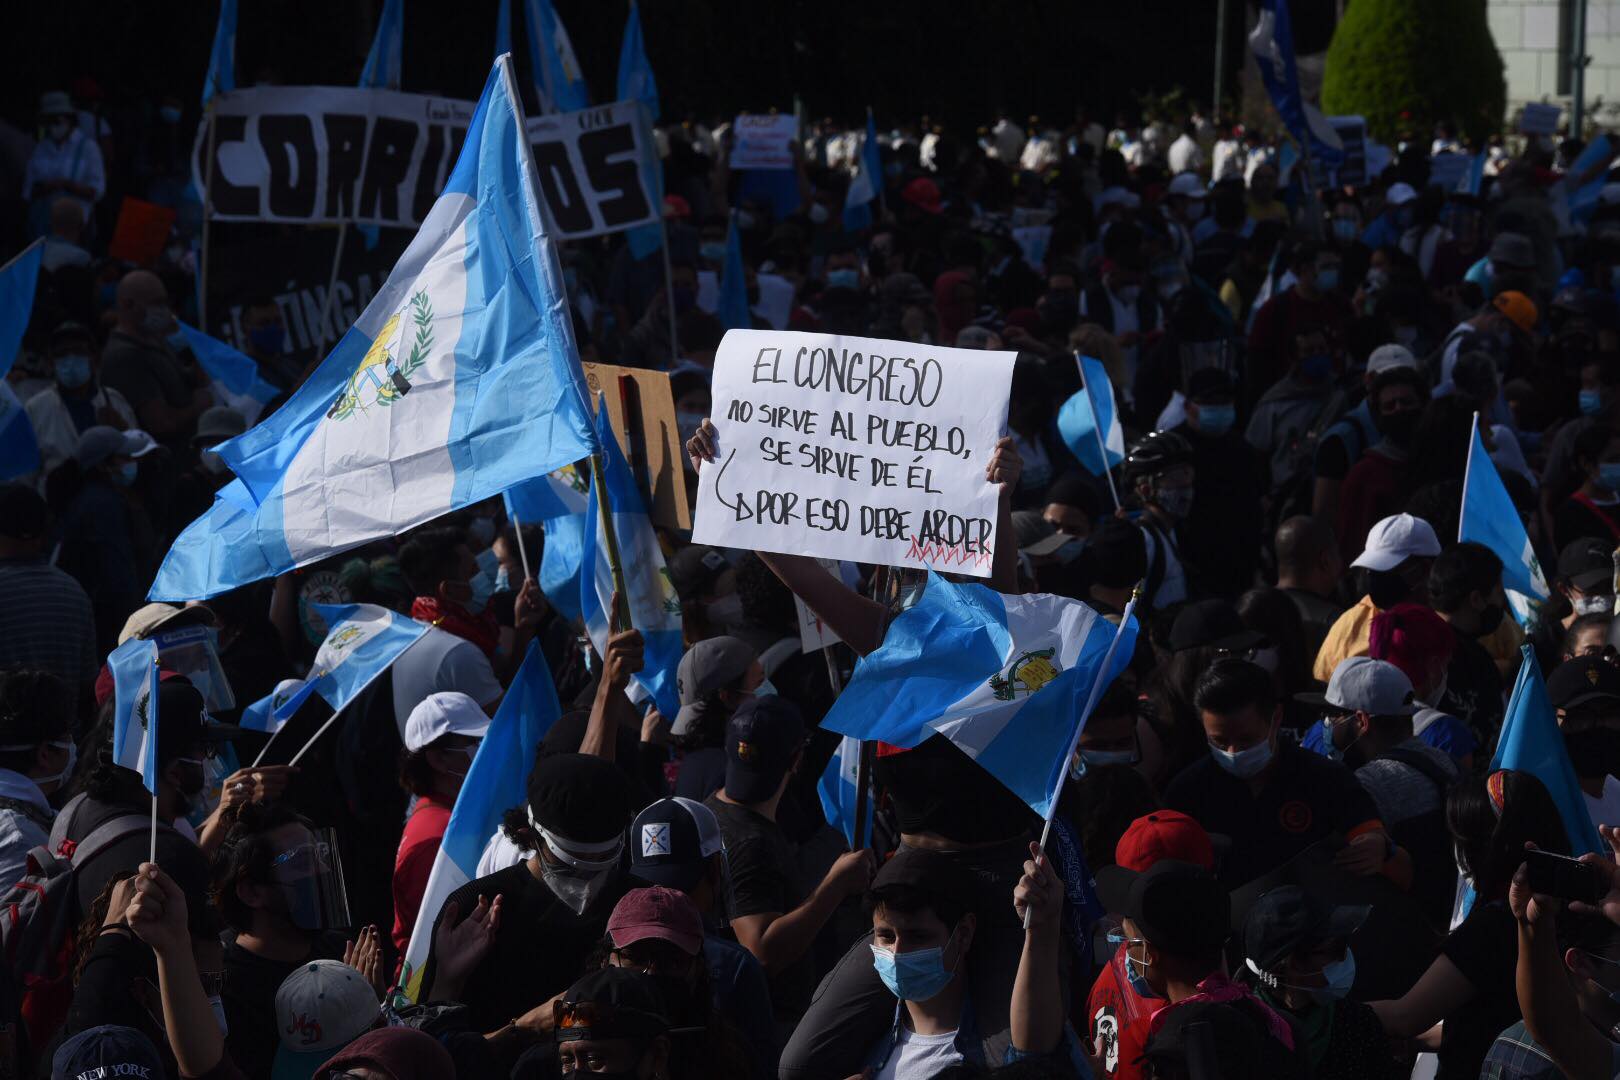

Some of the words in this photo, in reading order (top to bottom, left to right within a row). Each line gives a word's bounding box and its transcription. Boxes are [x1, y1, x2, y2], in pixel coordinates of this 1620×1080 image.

[751, 347, 788, 385] EL
[794, 346, 942, 407] CONGRESO
[758, 404, 819, 434] SIRVE
[830, 410, 858, 442] AL
[867, 414, 971, 460] PUEBLO,
[759, 436, 793, 466] SE
[799, 443, 865, 482] SIRVE
[871, 457, 898, 487] DE
[906, 455, 943, 494] ÉL
[756, 490, 801, 525] POR
[806, 498, 850, 532] ESO
[860, 505, 912, 542] DEBE
[918, 509, 992, 555] ARDER
[76, 1066, 108, 1080] NEW
[111, 1062, 152, 1080] YORK
